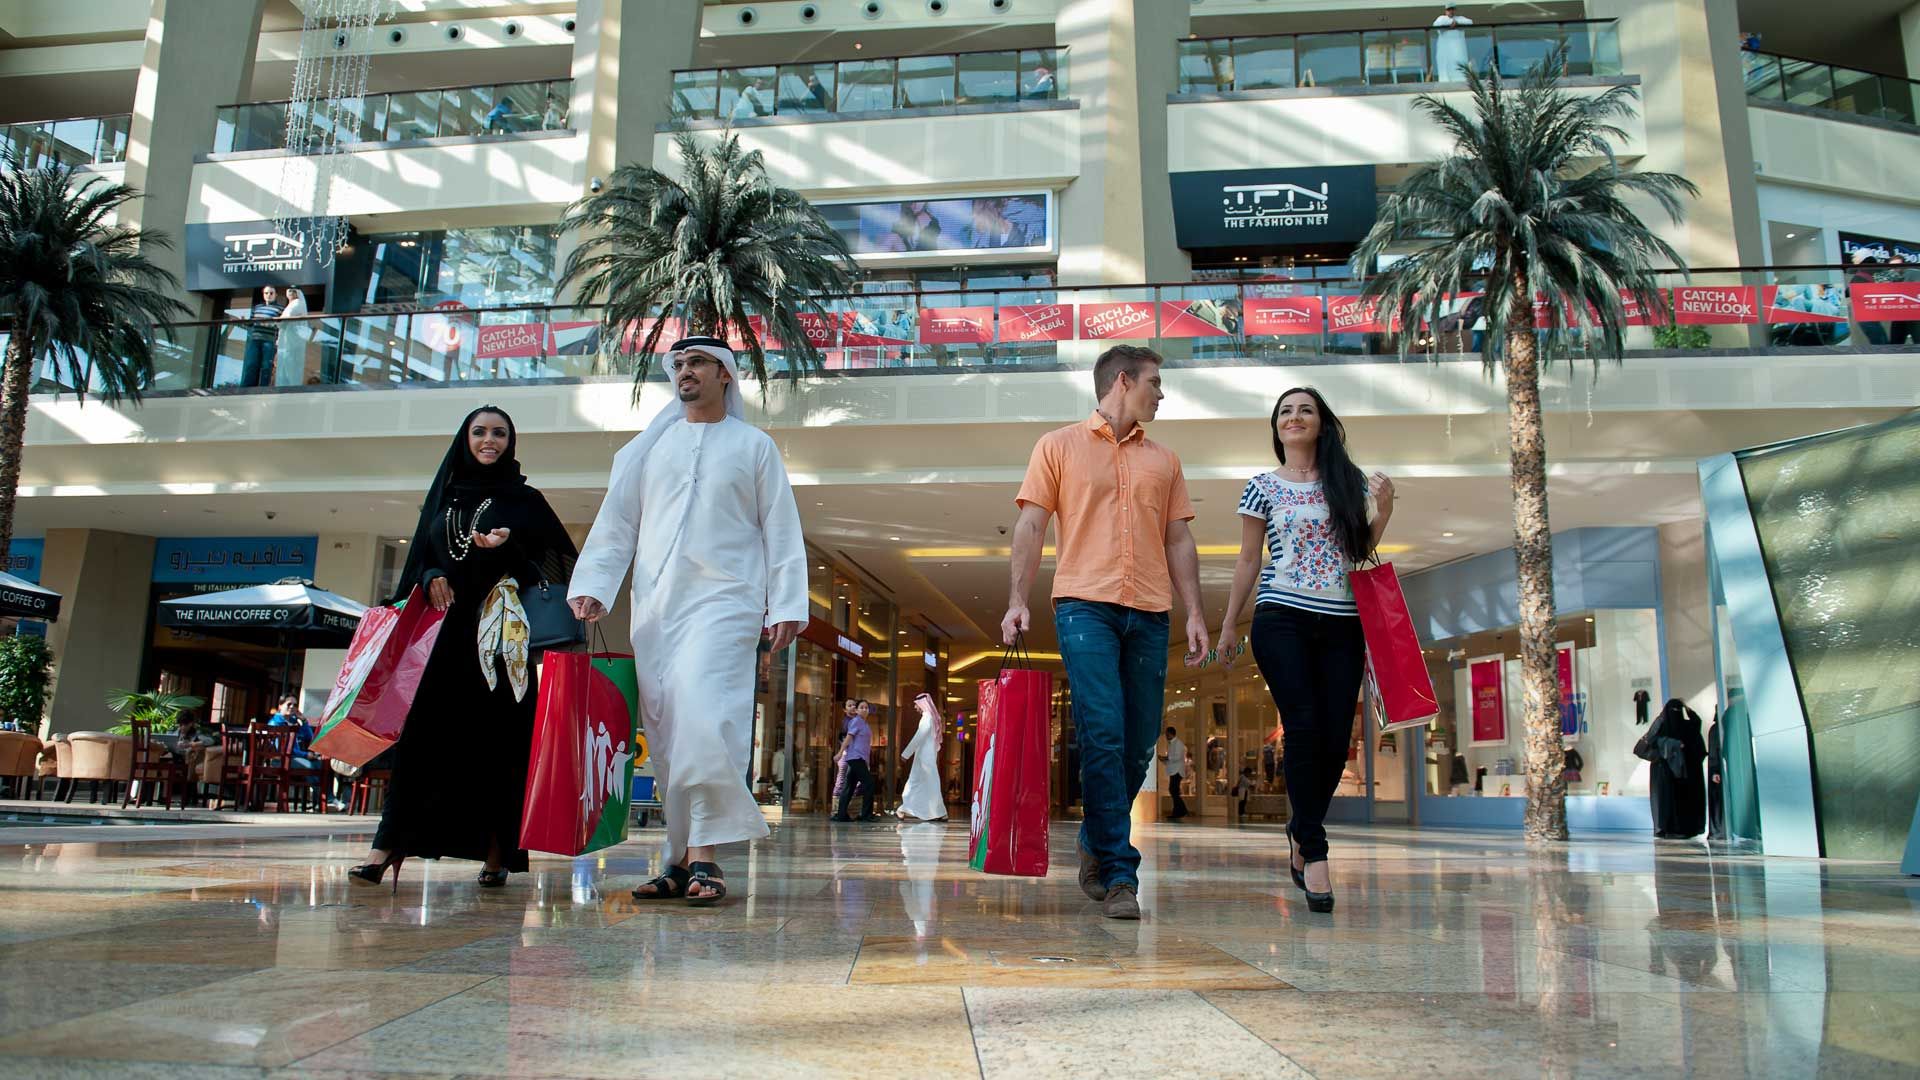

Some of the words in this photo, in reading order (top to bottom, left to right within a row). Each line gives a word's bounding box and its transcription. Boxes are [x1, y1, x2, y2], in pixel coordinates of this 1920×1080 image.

[1224, 219, 1245, 228] THE
[1249, 217, 1303, 227] FASHION
[1306, 215, 1328, 225] NET
[223, 264, 238, 273] THE
[241, 262, 282, 272] FASHION
[285, 261, 304, 270] NET
[1683, 290, 1725, 302] CATCH
[1728, 292, 1738, 302] A
[1683, 301, 1712, 312] NEW
[1715, 303, 1752, 314] LOOK
[1084, 308, 1123, 328] CATCH
[1125, 304, 1135, 315] A
[1335, 311, 1364, 327] NEW
[1087, 323, 1115, 338] NEW
[1116, 309, 1149, 331] LOOK
[481, 326, 516, 343] CATCH
[517, 326, 526, 336] A
[482, 340, 506, 353] NEW
[508, 333, 537, 348] LOOK
[193, 584, 206, 592] THE
[2, 590, 33, 607] COFFEE
[176, 609, 193, 620] THE
[197, 609, 232, 620] ITALIAN
[233, 609, 271, 620] COFFEE
[323, 614, 338, 626] THE
